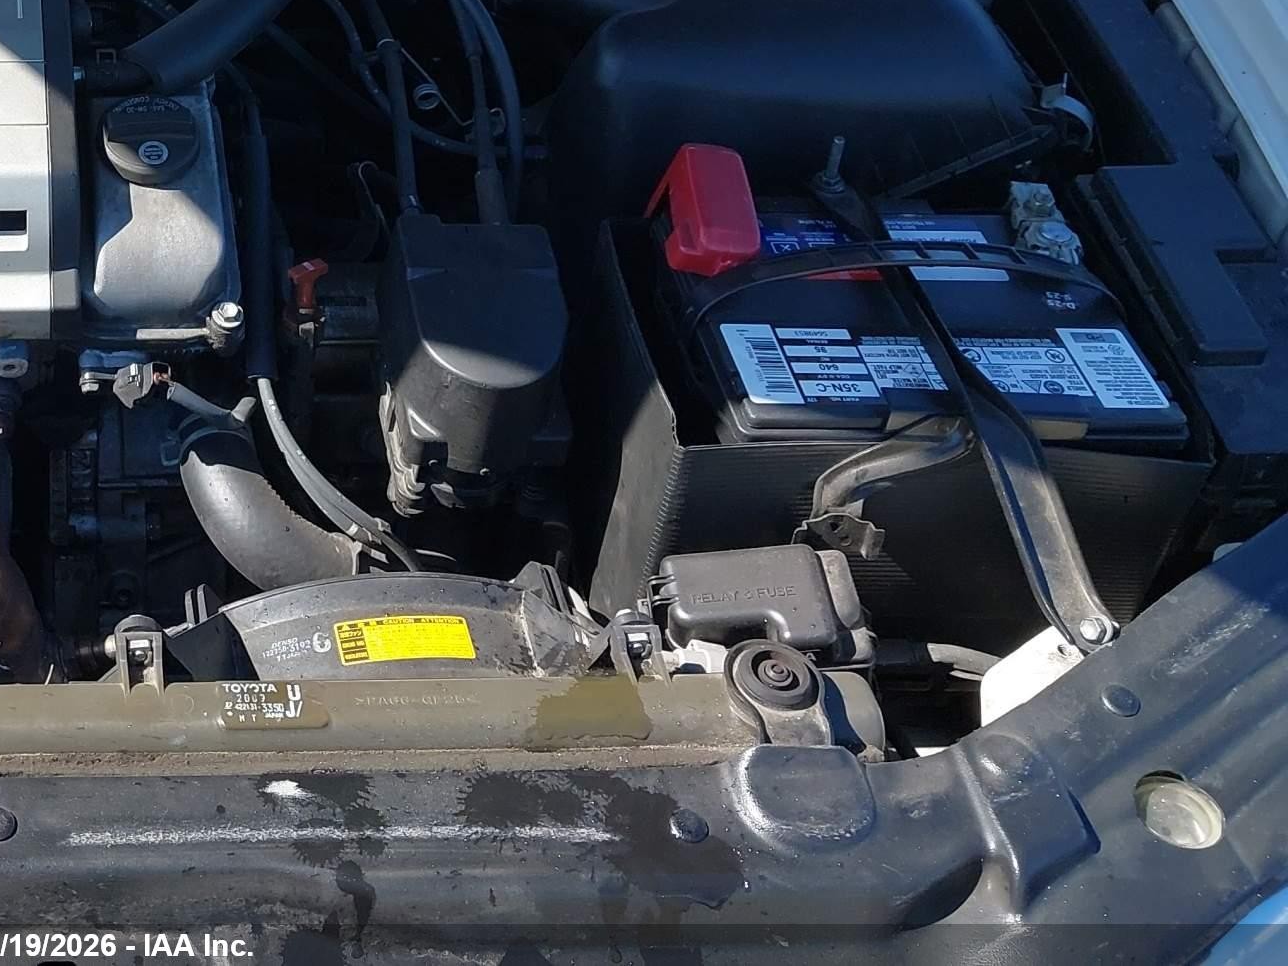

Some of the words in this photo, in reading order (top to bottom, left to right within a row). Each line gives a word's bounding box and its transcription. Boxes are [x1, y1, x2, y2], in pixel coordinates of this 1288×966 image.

[818, 363, 839, 371] 640
[815, 381, 862, 393] 35N-C
[689, 590, 740, 605] RELAY
[755, 585, 797, 599] FUSE
[221, 683, 278, 693] TOYOTA
[286, 684, 301, 701] U
